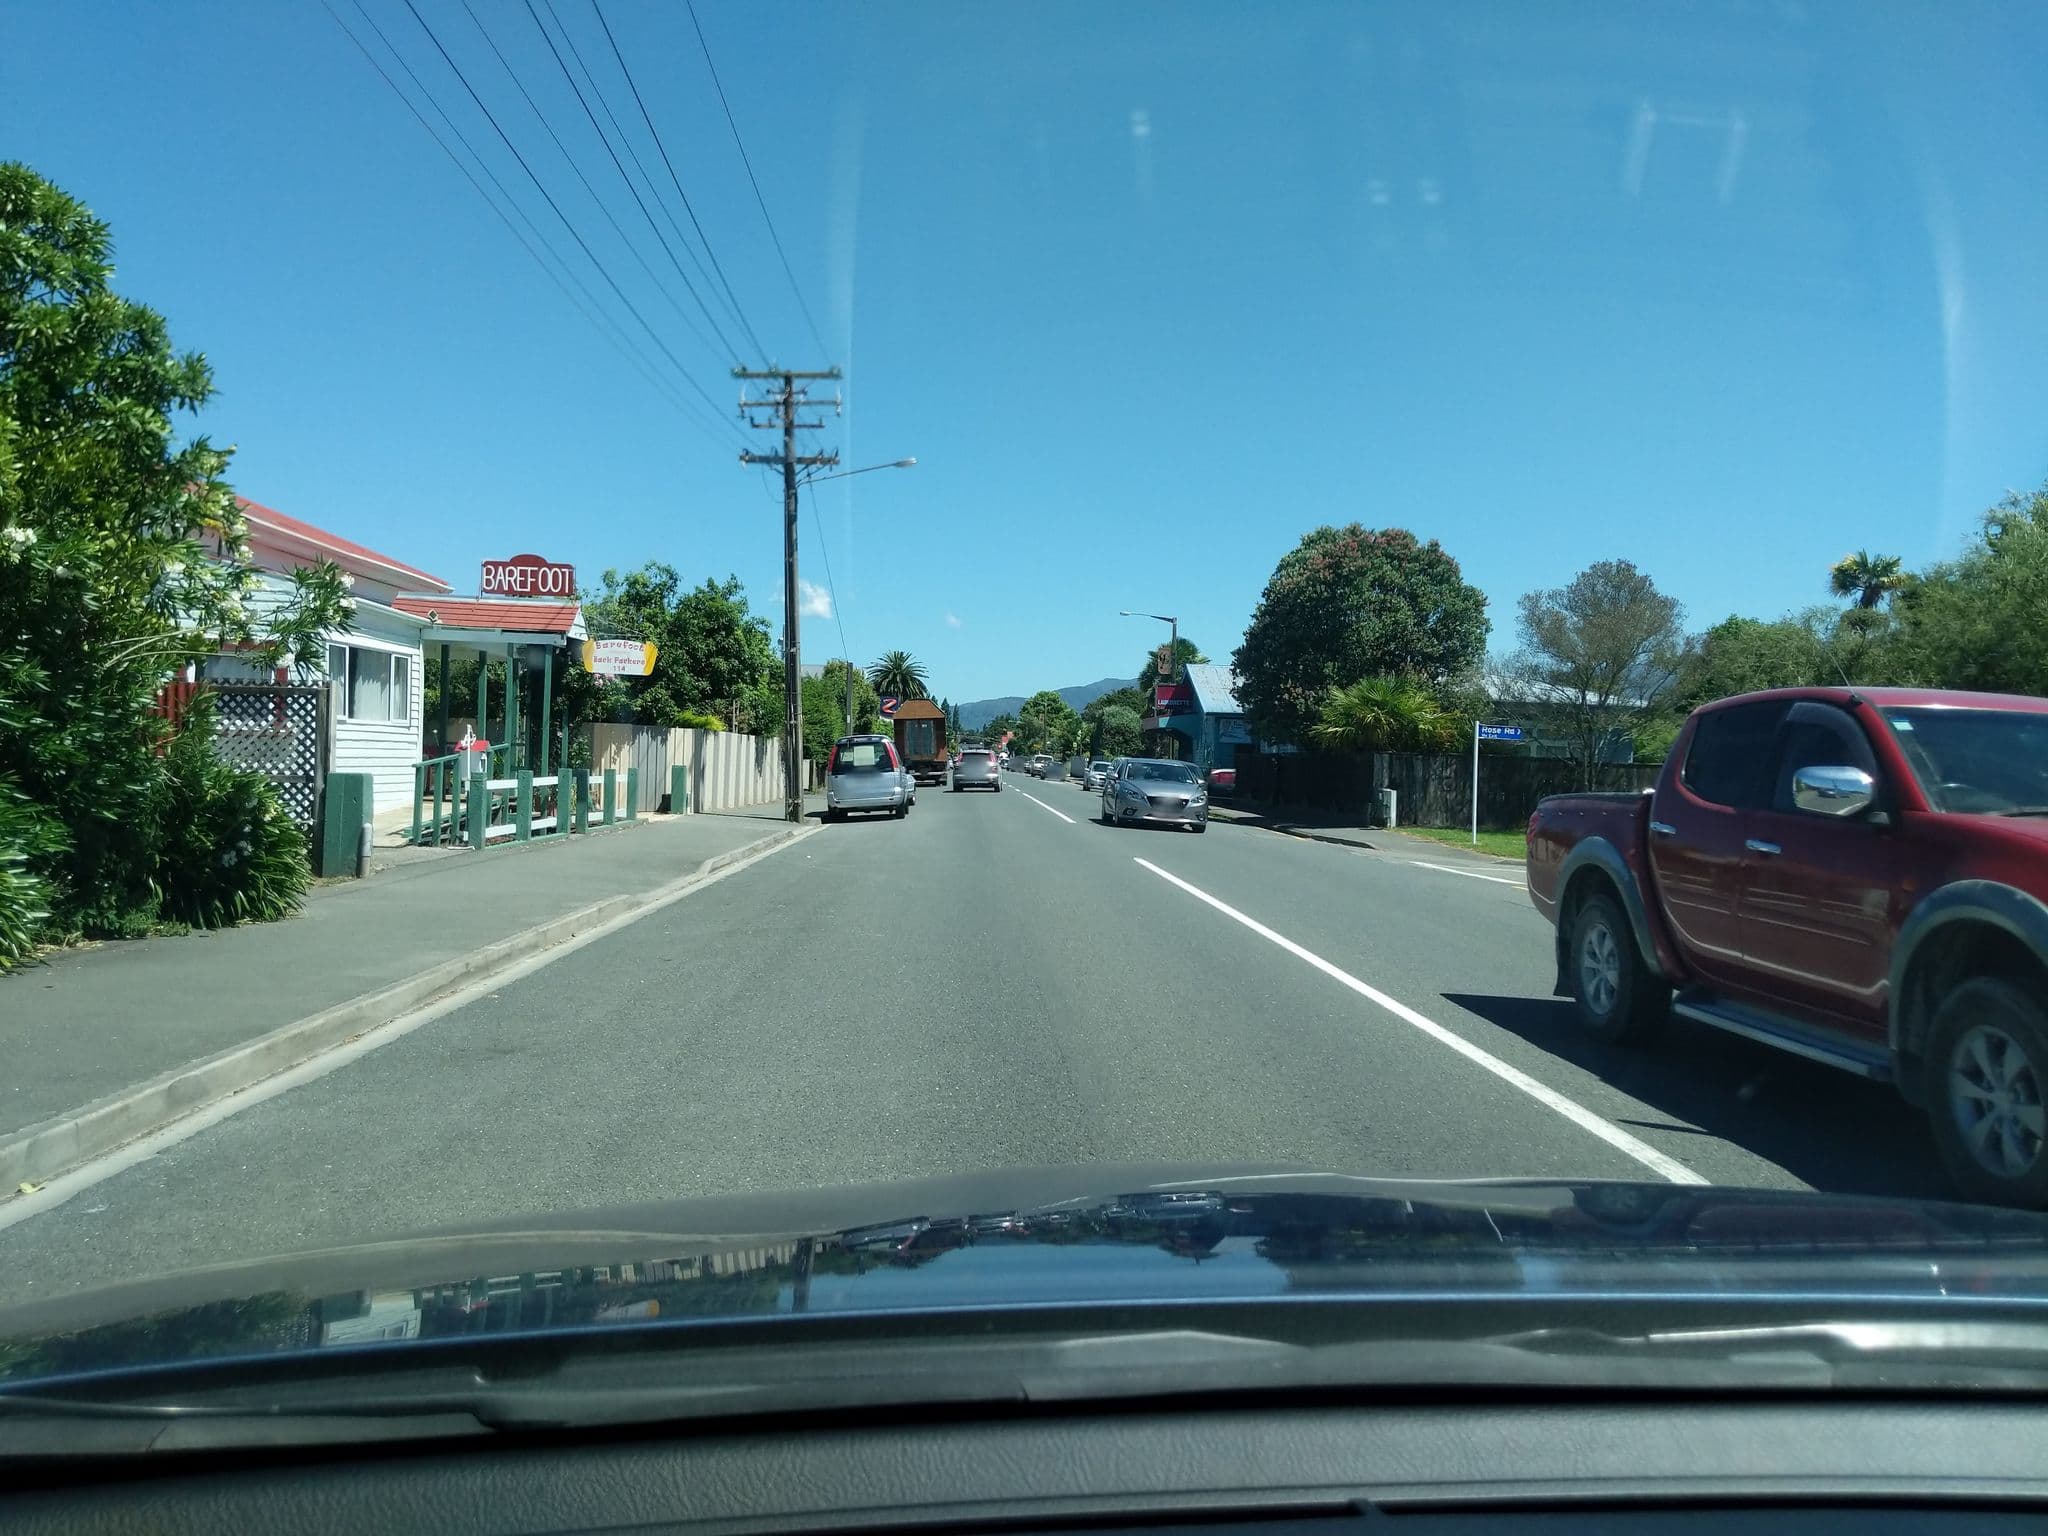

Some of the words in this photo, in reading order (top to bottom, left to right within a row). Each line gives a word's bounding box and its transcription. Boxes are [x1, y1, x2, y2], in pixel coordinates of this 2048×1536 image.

[483, 565, 573, 593] BAREFOOT
[1481, 726, 1502, 734] Rose
[1504, 727, 1515, 735] Rd
